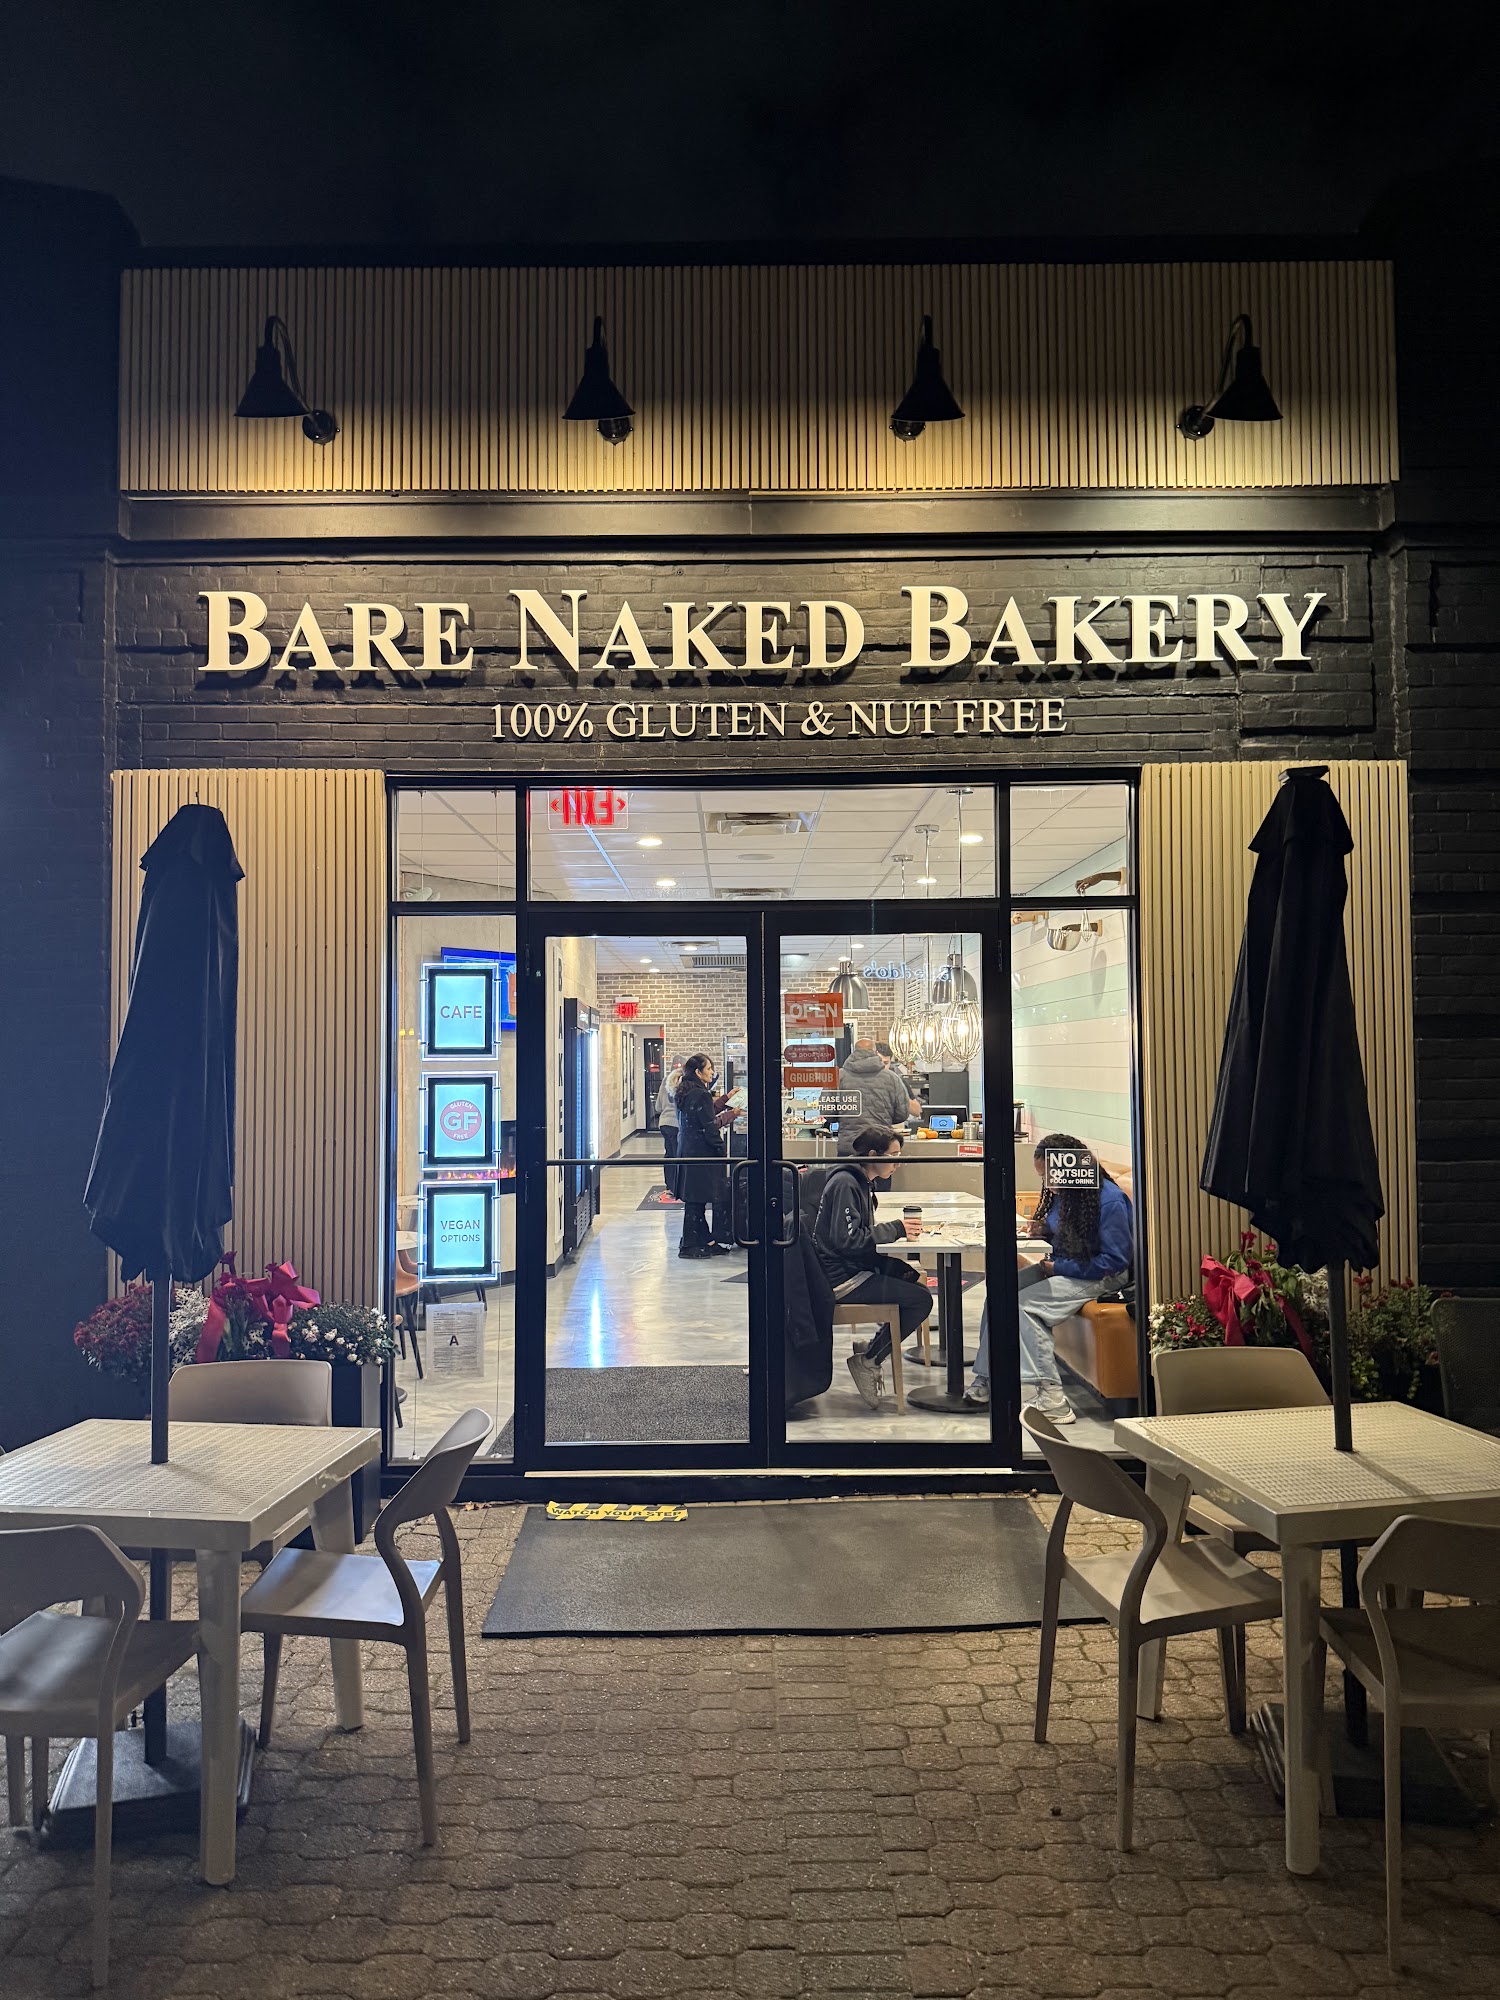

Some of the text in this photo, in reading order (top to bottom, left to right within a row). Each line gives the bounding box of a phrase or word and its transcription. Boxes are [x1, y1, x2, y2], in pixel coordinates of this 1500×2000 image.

[198, 585, 1327, 673] BARE NAKED BAKERY
[491, 698, 1068, 739] 100% GLUTEN & NUT FREE
[440, 1005, 482, 1019] CAFE
[620, 1003, 637, 1017] EXIT
[790, 1003, 838, 1019] OPEN
[790, 1073, 834, 1083] GRUBHUB
[842, 1095, 858, 1103] USE
[450, 1101, 473, 1109] GLUTEN
[443, 1111, 479, 1131] GF
[1049, 1152, 1077, 1168] NO
[1049, 1168, 1095, 1178] OUTSIDE
[440, 1219, 481, 1230] VEGAN
[440, 1233, 481, 1243] OPTIONS
[449, 1335, 459, 1346] A
[551, 1507, 600, 1516] WATCH
[604, 1509, 642, 1517] YOUR
